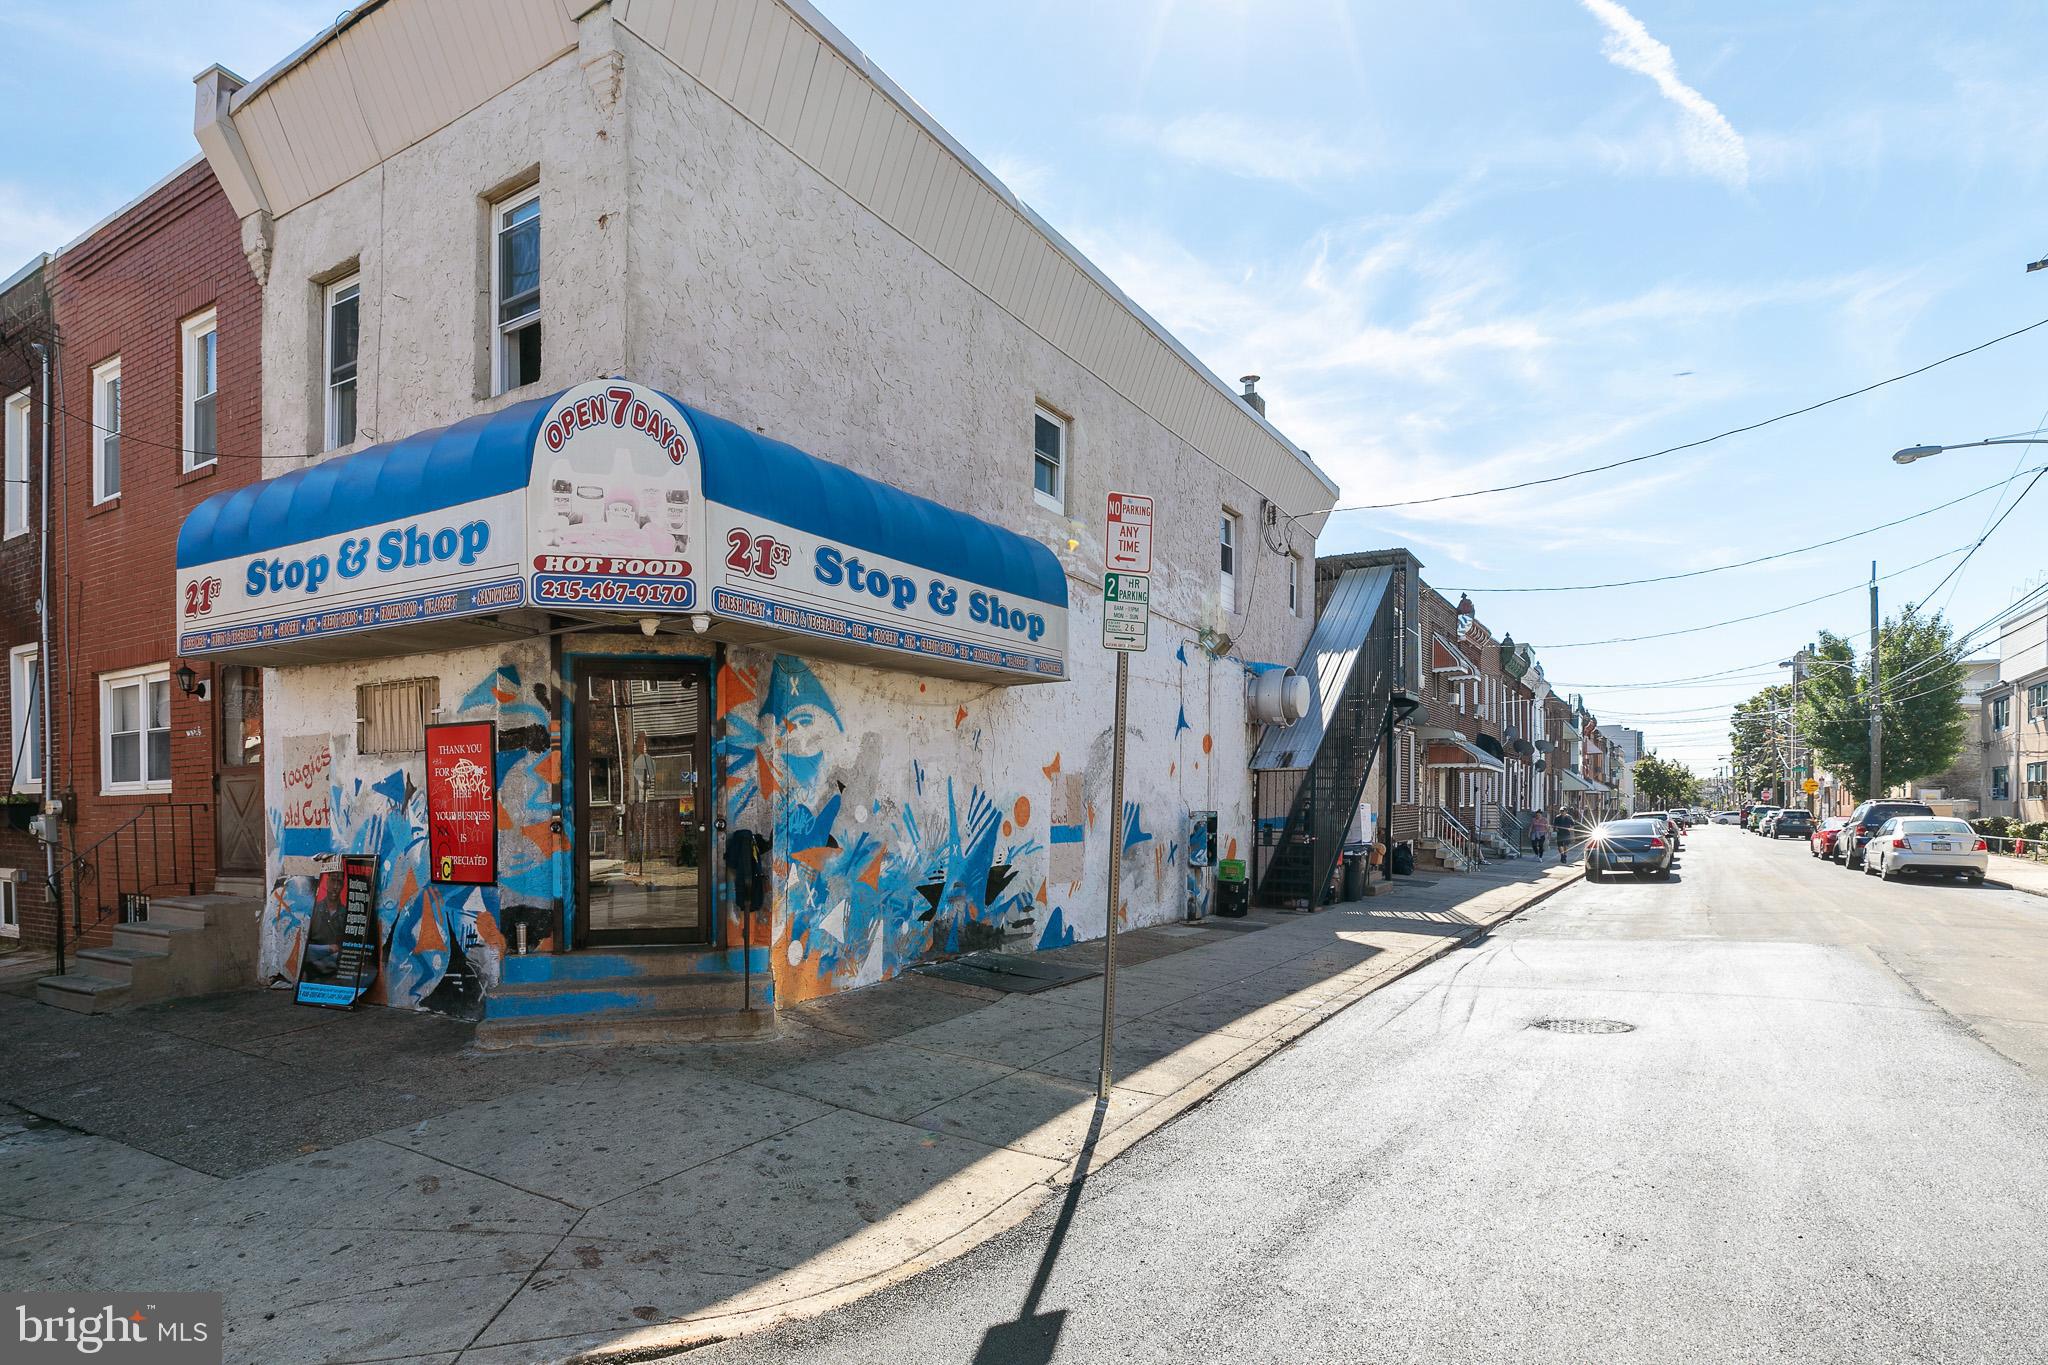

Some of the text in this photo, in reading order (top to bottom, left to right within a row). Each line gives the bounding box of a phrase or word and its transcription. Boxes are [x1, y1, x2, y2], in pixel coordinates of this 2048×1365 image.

[545, 386, 688, 465] OPEN 7 DAYS
[1108, 501, 1151, 517] NO PARKING
[1120, 526, 1139, 538] ANY
[725, 527, 791, 579] 21ST
[1118, 540, 1140, 552] TIME
[245, 520, 491, 596] Stop & Shop
[544, 556, 683, 576] HOT FOOD
[541, 580, 687, 603] 215-467-9170
[814, 545, 1046, 642] Stop & Shop
[1107, 577, 1140, 597] 2 HR
[1119, 590, 1147, 602] PARKING
[185, 576, 221, 619] 21ST
[379, 602, 401, 621] FROZEN
[400, 600, 418, 618] FOOD
[424, 598, 434, 615] WE
[434, 594, 458, 614] ACCEPT
[476, 583, 521, 606] SANDWICHES
[718, 593, 743, 612] FRESH
[744, 599, 765, 617] MEAT
[774, 606, 799, 625] FRUITS
[800, 614, 807, 627] &
[807, 613, 846, 635] VEGETABLES
[873, 628, 899, 645] GROCERY
[903, 634, 916, 649] ATM
[438, 744, 482, 755] THANK YOU
[435, 767, 450, 777] FOR
[457, 811, 491, 821] BUSINESS
[460, 833, 467, 843] IS
